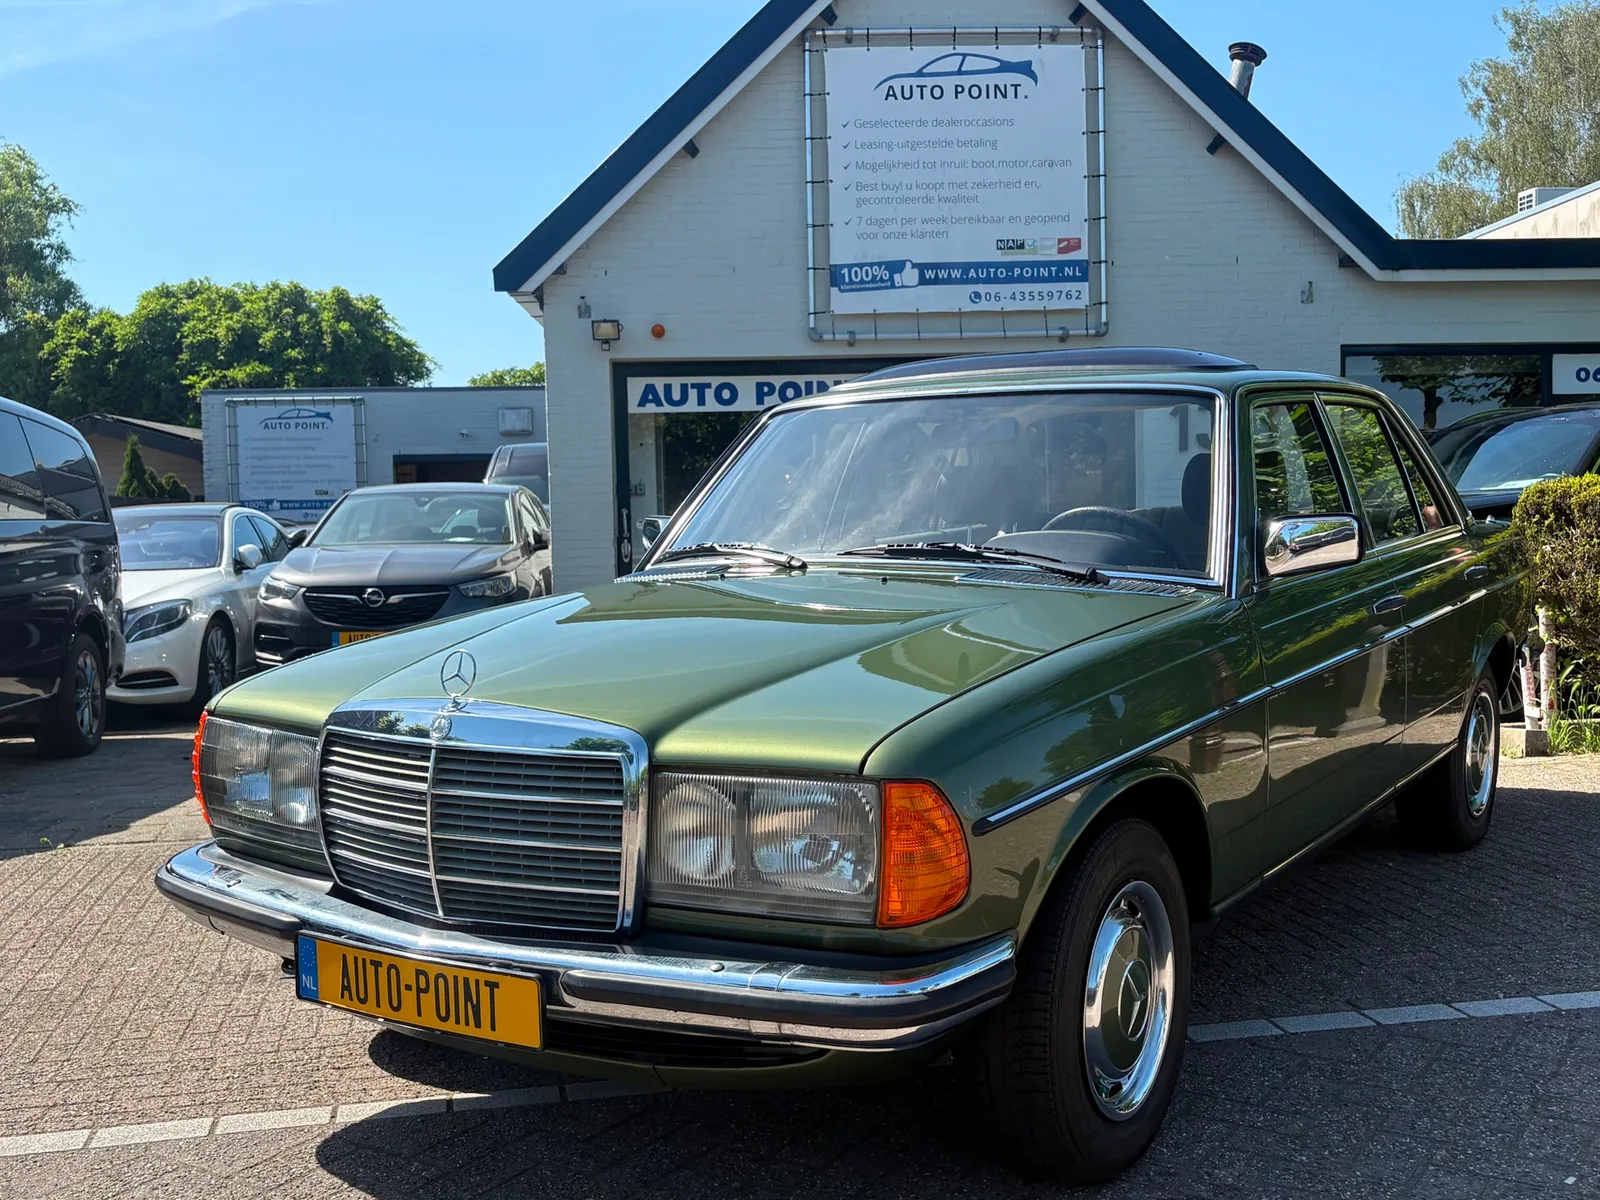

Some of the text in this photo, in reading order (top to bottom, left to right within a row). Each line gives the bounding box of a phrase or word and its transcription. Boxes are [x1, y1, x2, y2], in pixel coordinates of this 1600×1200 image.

[885, 83, 1028, 101] AUTO POINT.
[853, 117, 1015, 129] Geselecteerde dealeroccasions
[854, 138, 998, 152] Leasing-uitgestelde betaling
[855, 158, 1072, 173] Mogelijkheid tot inruil: boot,motor,caravan
[855, 178, 1040, 193] Best buy! u koopt met zekerheid en,
[855, 194, 980, 208] gecontroleerde kwaliteit
[856, 213, 1070, 229] 7 dagen per week bereikbaar en geopend
[855, 229, 949, 240] voor onze klanten
[997, 239, 1025, 250] NAP
[840, 265, 890, 283] 100%
[924, 266, 1082, 279] WWW.AUTO-POINT.NL
[984, 289, 1082, 302] 06-43559762
[637, 381, 739, 408] AUTO
[263, 421, 329, 430] AUTO POINT.
[302, 953, 500, 1032] NL AUTO-POINT
